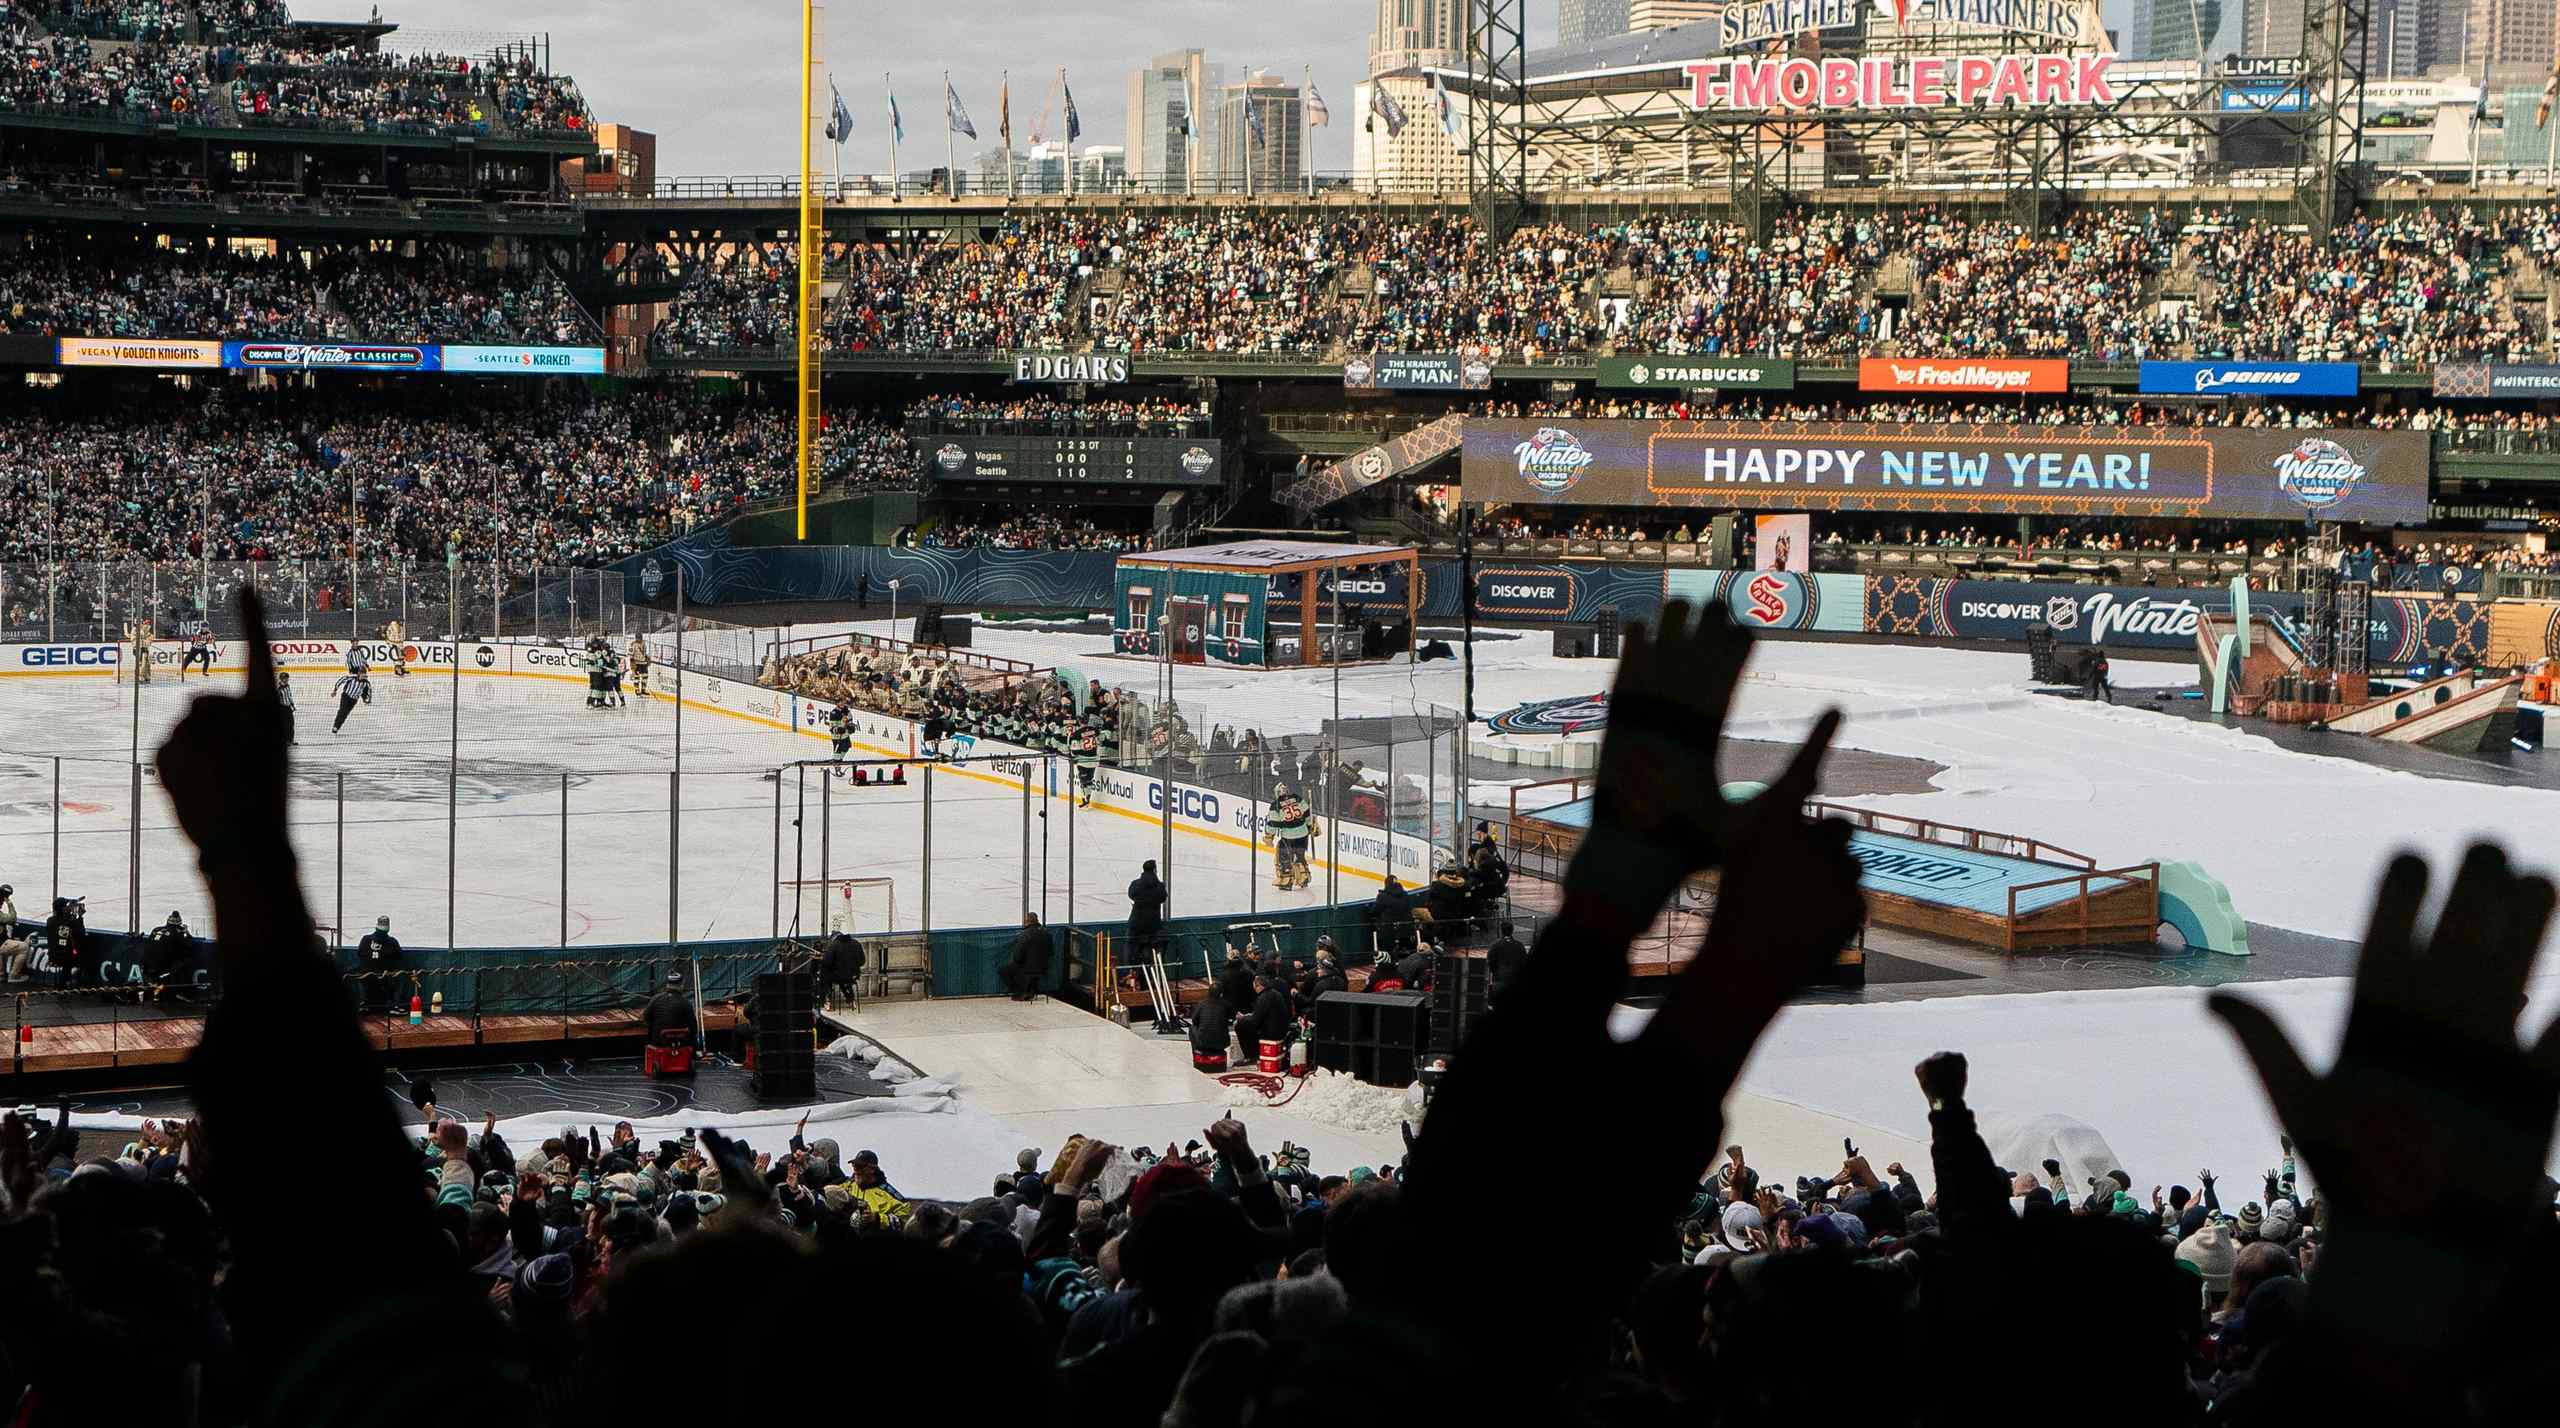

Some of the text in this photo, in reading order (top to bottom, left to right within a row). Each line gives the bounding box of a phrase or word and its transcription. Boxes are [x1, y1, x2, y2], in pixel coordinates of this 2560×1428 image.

[1722, 0, 2081, 46] SEATTLE MARINERS
[2223, 59, 2310, 76] LUMEN
[1682, 53, 2120, 110] T-MOBILE PARK
[81, 348, 111, 356] VEGAS
[122, 347, 155, 360] GOLDEN
[157, 348, 200, 360] KNIGHTS
[249, 351, 283, 360] DISCOVER
[299, 346, 353, 368] Winter
[354, 352, 399, 361] CLASSIC
[477, 355, 520, 363] SEATTLE
[533, 354, 571, 366] KRAKEN
[1016, 355, 1127, 382] EDGAR'S
[1389, 360, 1405, 368] THE
[1382, 369, 1406, 383] 7TH
[1411, 369, 1453, 383] MAN
[1655, 368, 1761, 382] STARBUCKS
[2220, 371, 2301, 384] BOEING
[1068, 441, 1074, 450] 2
[1080, 441, 1086, 450] 3
[1089, 442, 1100, 450] OT
[1127, 442, 1133, 450] T
[976, 451, 1133, 464] Vegas 0 0 0 0
[1513, 441, 1593, 477] Winter
[975, 466, 1007, 476] Seattle
[1079, 468, 1086, 478] 0
[1126, 469, 1133, 479] 2
[1533, 465, 1574, 473] CLASSIC
[1704, 447, 2151, 490] HAPPY NEW YEAR!
[2272, 453, 2365, 491] Winter
[2293, 478, 2343, 487] CLASSIC
[2450, 506, 2509, 518] BULLPEN
[2512, 508, 2540, 520] BAR
[1491, 584, 1557, 599] DISCOVER
[1962, 602, 2042, 620] DISCOVER
[2082, 592, 2200, 644] Winte
[22, 646, 122, 665] GEICO
[271, 643, 339, 654] ONDA
[358, 644, 454, 663] DISCOVER
[527, 649, 566, 666] Great
[989, 752, 1029, 777] verizo
[1089, 773, 1134, 800] ssMutual
[1149, 783, 1219, 823] GEICO
[1282, 802, 1302, 823] 35
[1848, 843, 1969, 883] RAKEN
